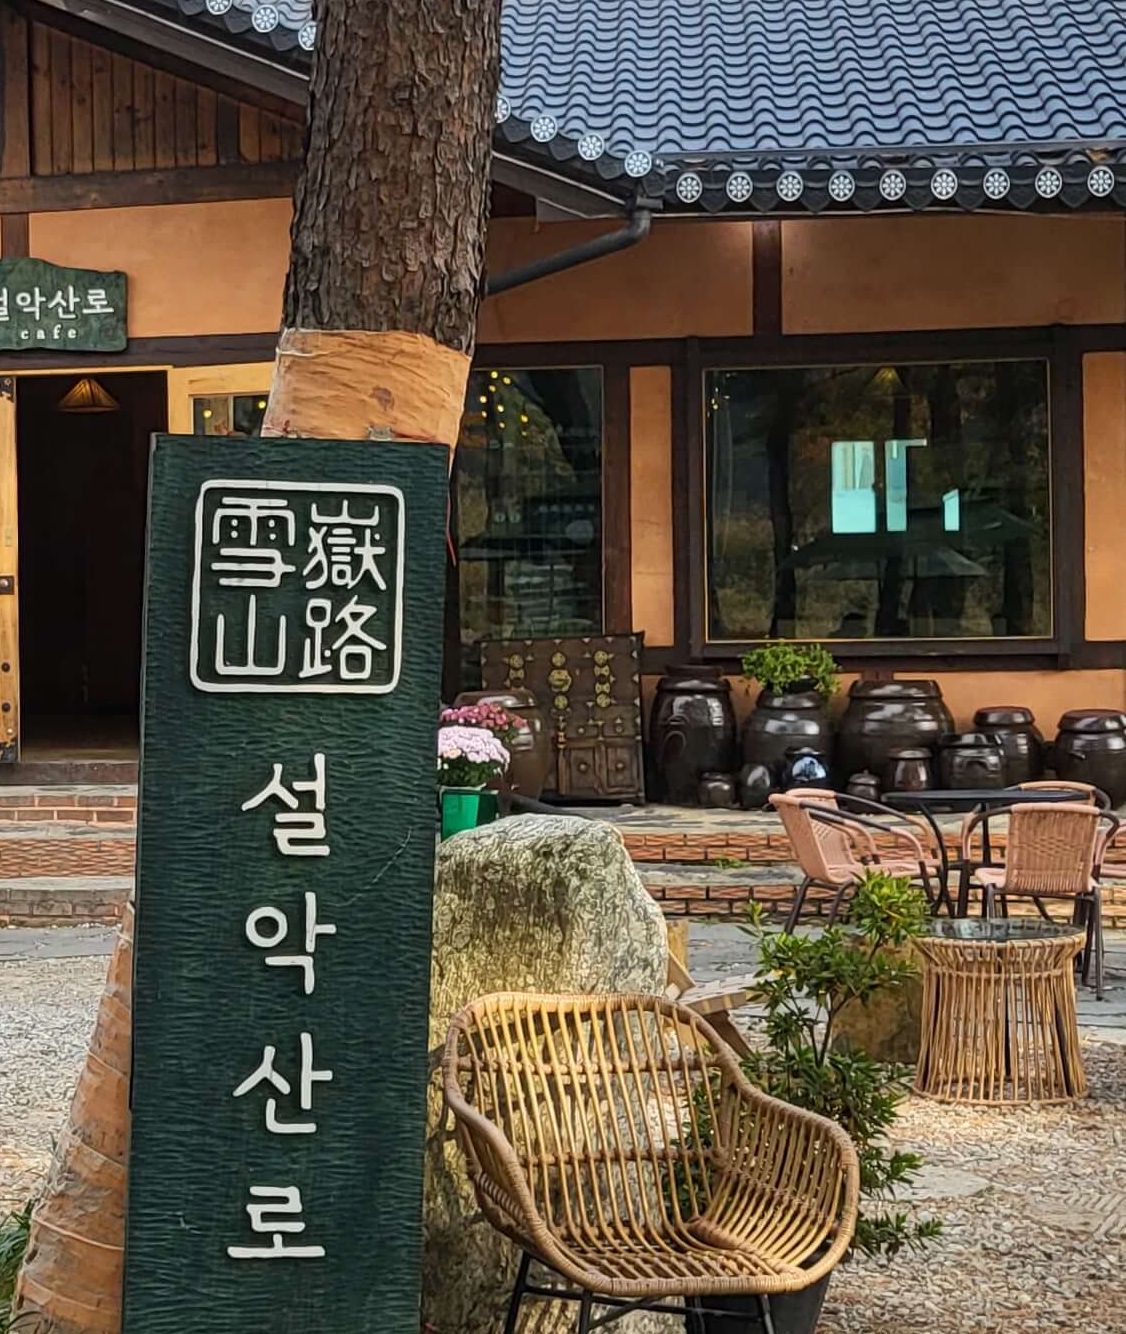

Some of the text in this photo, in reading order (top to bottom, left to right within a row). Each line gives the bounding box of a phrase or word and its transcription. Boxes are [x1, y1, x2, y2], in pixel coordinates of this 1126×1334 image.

[20, 324, 77, 340] cafe
[211, 497, 387, 590] 雪嶽
[214, 595, 388, 680] 山路
[227, 753, 338, 1259] 설악산로
